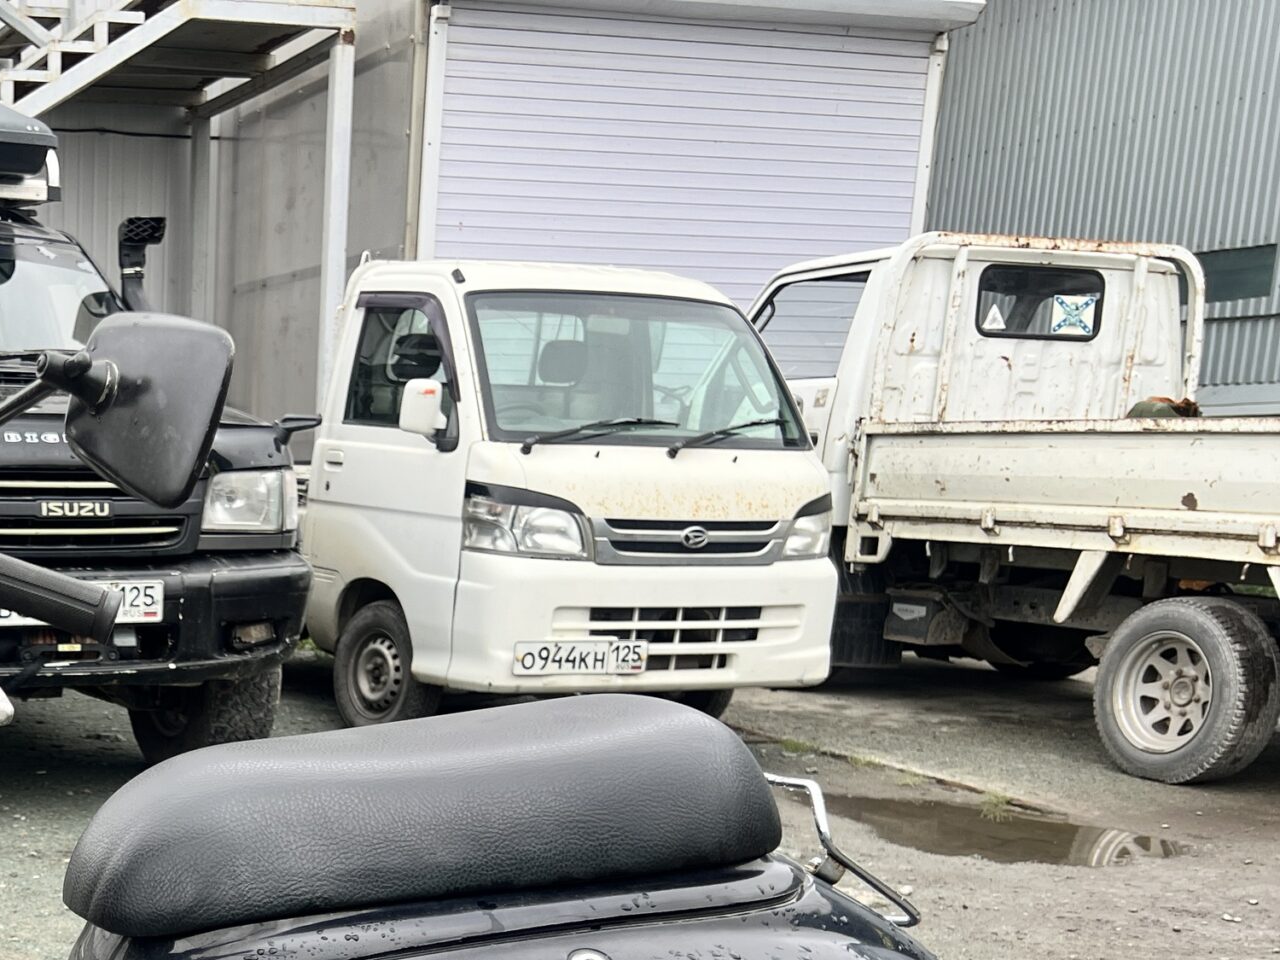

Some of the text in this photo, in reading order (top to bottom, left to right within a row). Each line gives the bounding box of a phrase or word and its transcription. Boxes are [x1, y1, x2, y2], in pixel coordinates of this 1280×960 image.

[40, 501, 110, 517] ISUZU
[120, 585, 155, 607] 125
[612, 644, 642, 663] 125
